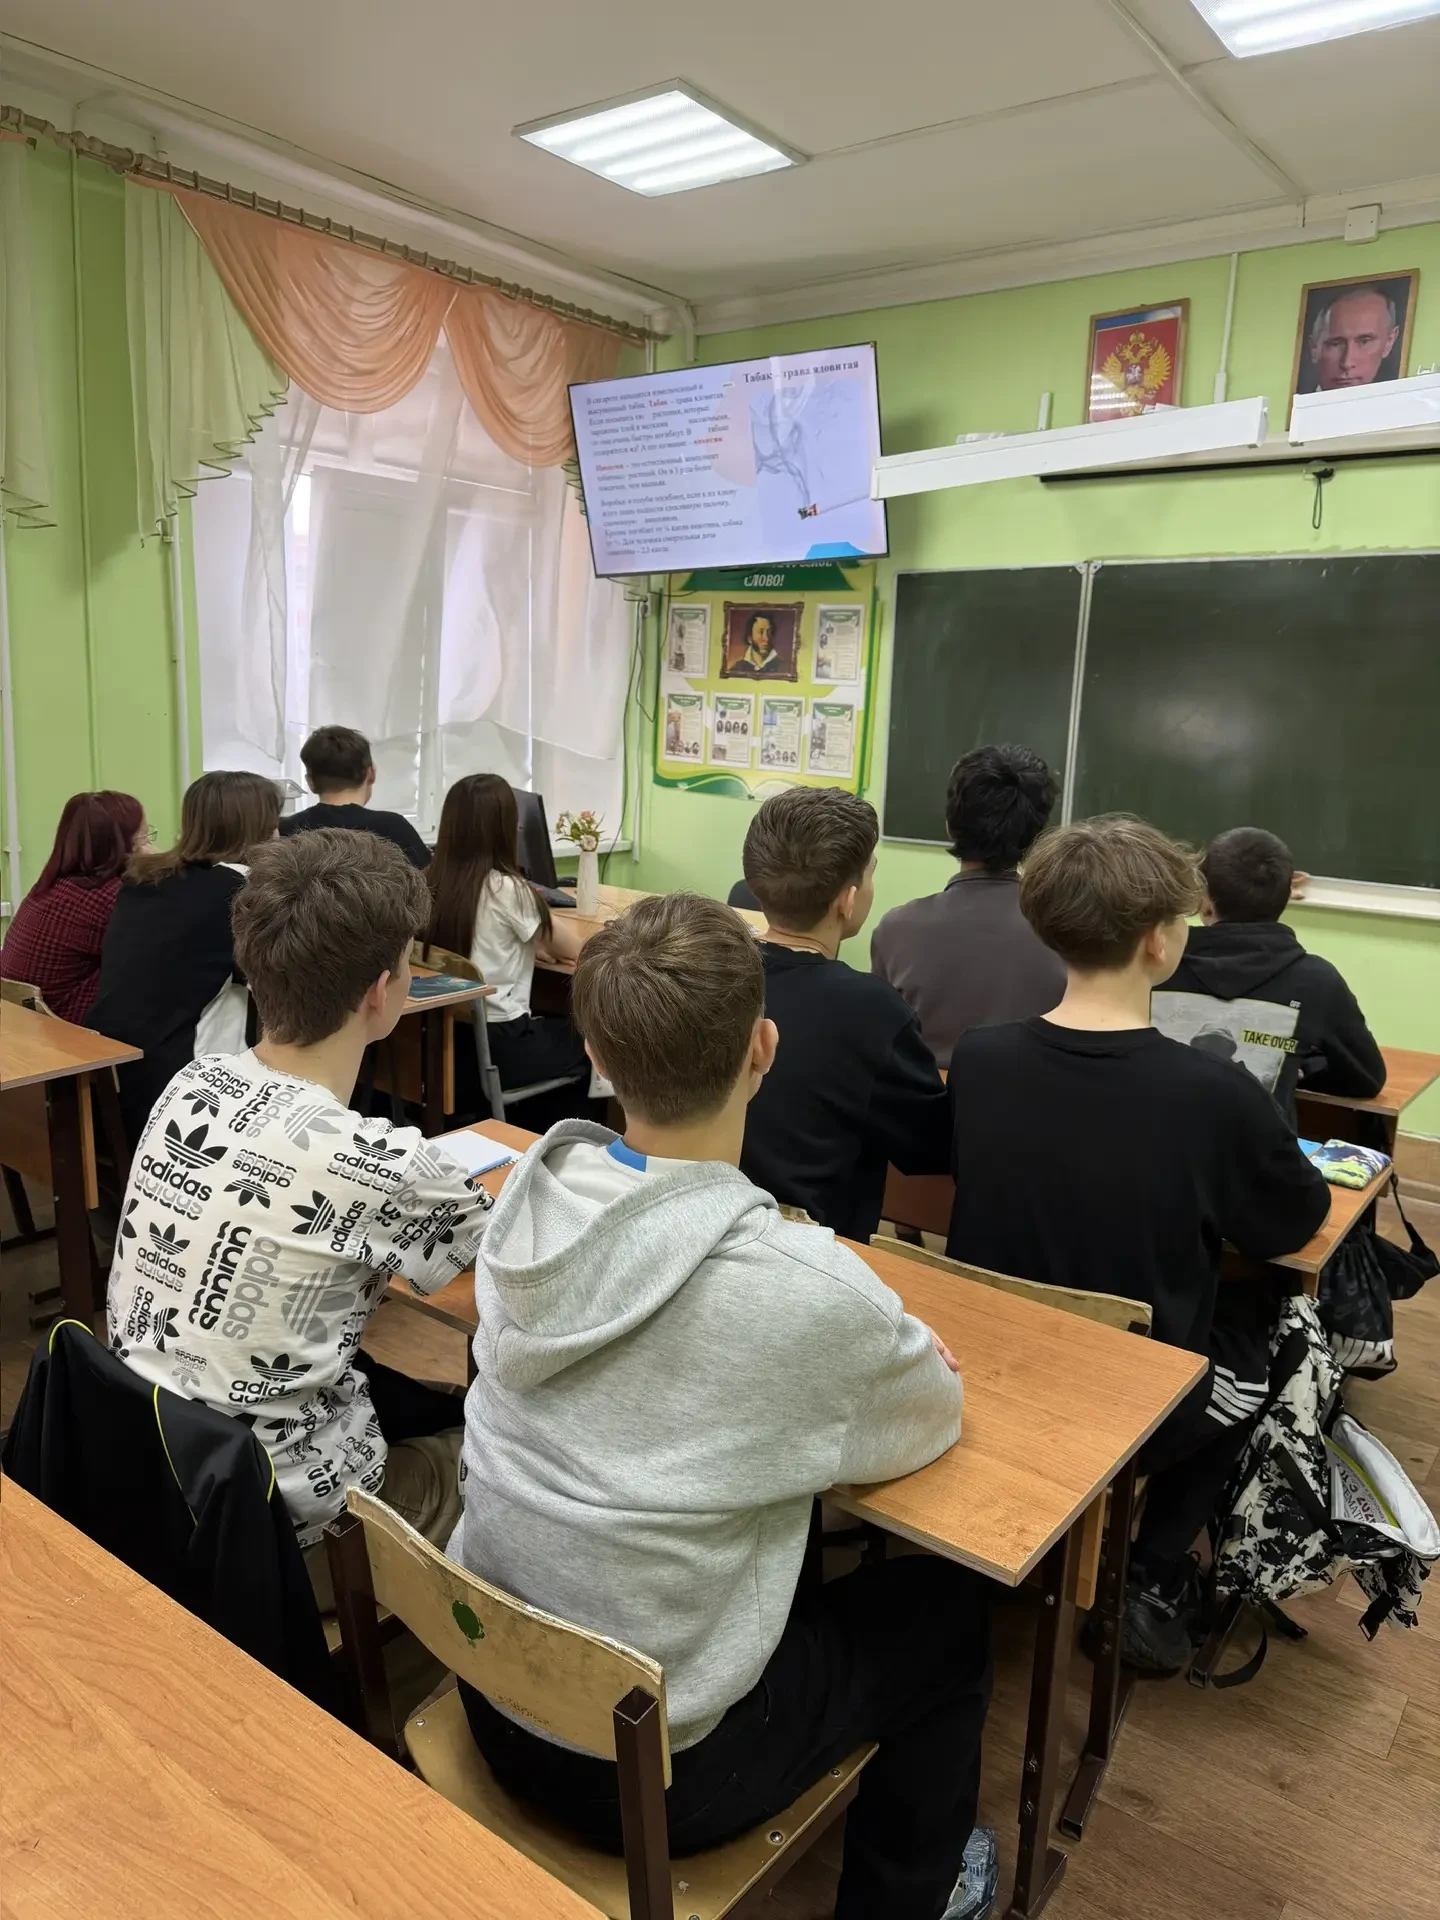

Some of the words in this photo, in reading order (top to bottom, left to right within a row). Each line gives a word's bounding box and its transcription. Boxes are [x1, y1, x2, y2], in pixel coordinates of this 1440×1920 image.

[744, 372, 772, 384] Табак
[783, 368, 811, 380] трава
[813, 360, 858, 374] ядовитая
[744, 574, 784, 586] СЛОВО!
[1243, 1030, 1271, 1047] TAKE
[198, 1070, 244, 1099] adidas
[140, 1154, 213, 1202] adidas
[232, 1159, 292, 1188] adidas
[334, 1152, 403, 1182] adidas
[330, 1200, 368, 1254] adidas
[138, 1246, 187, 1279] adidas
[221, 1236, 282, 1341] adidas
[136, 1290, 154, 1343] adidas
